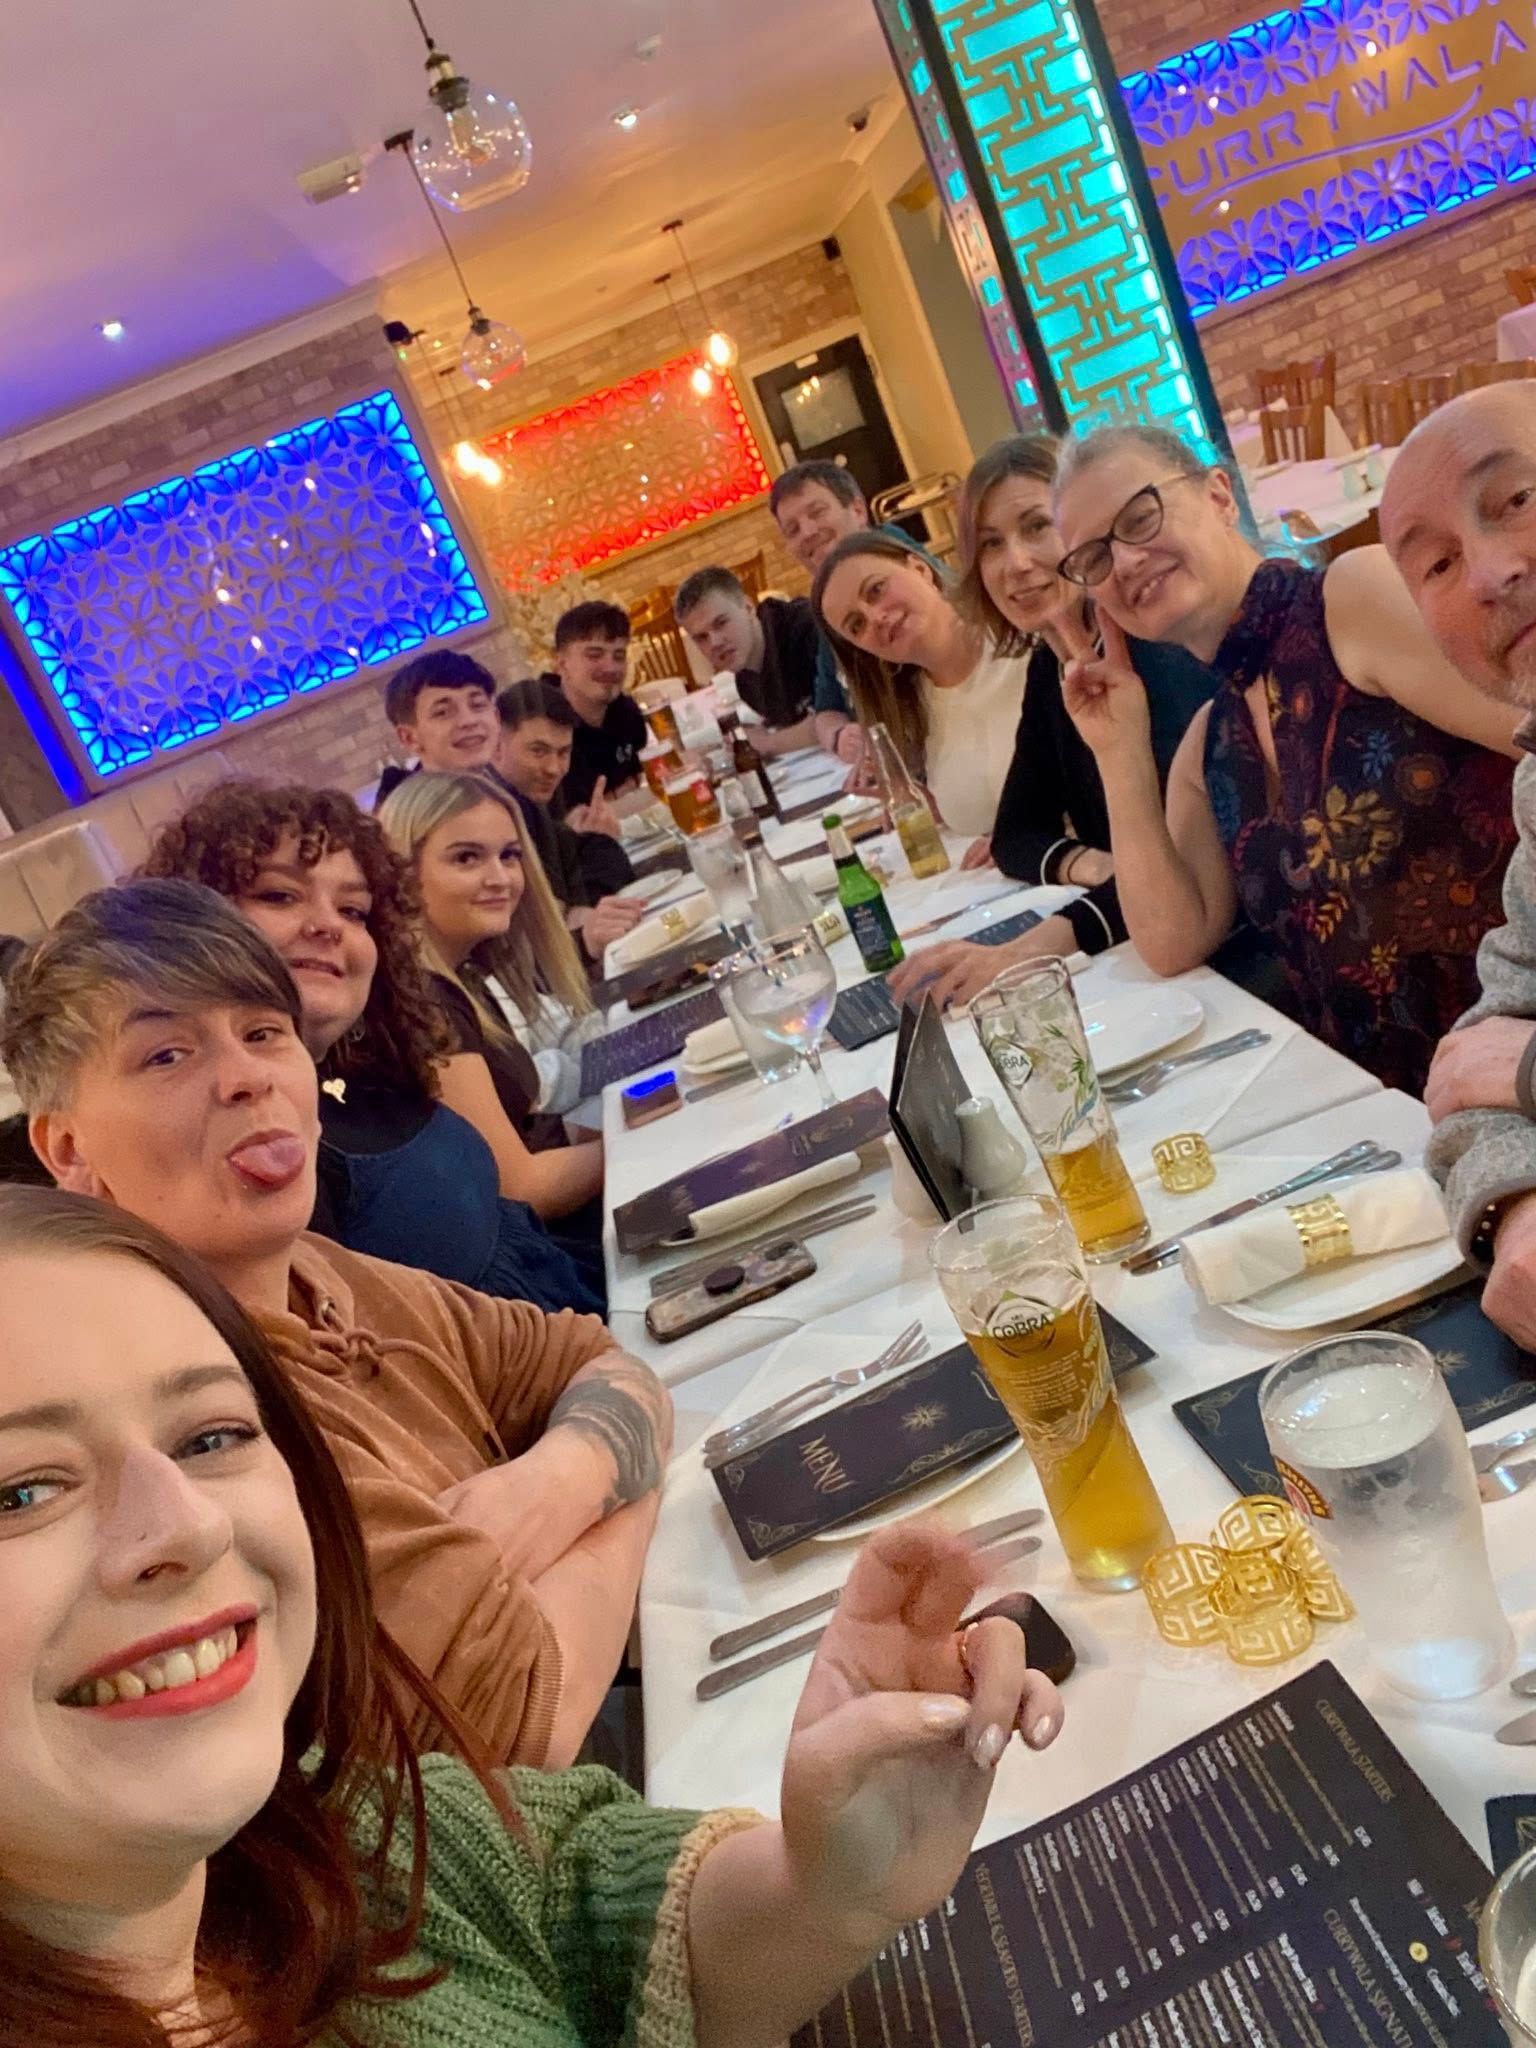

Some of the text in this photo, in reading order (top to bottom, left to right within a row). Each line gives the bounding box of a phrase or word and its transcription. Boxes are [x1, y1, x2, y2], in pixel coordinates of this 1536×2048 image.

[1148, 19, 1527, 207] URRYWALA
[992, 1313, 1053, 1341] COBRA
[798, 1433, 857, 1494] MENU
[1323, 1908, 1375, 1992] CURRYWALA
